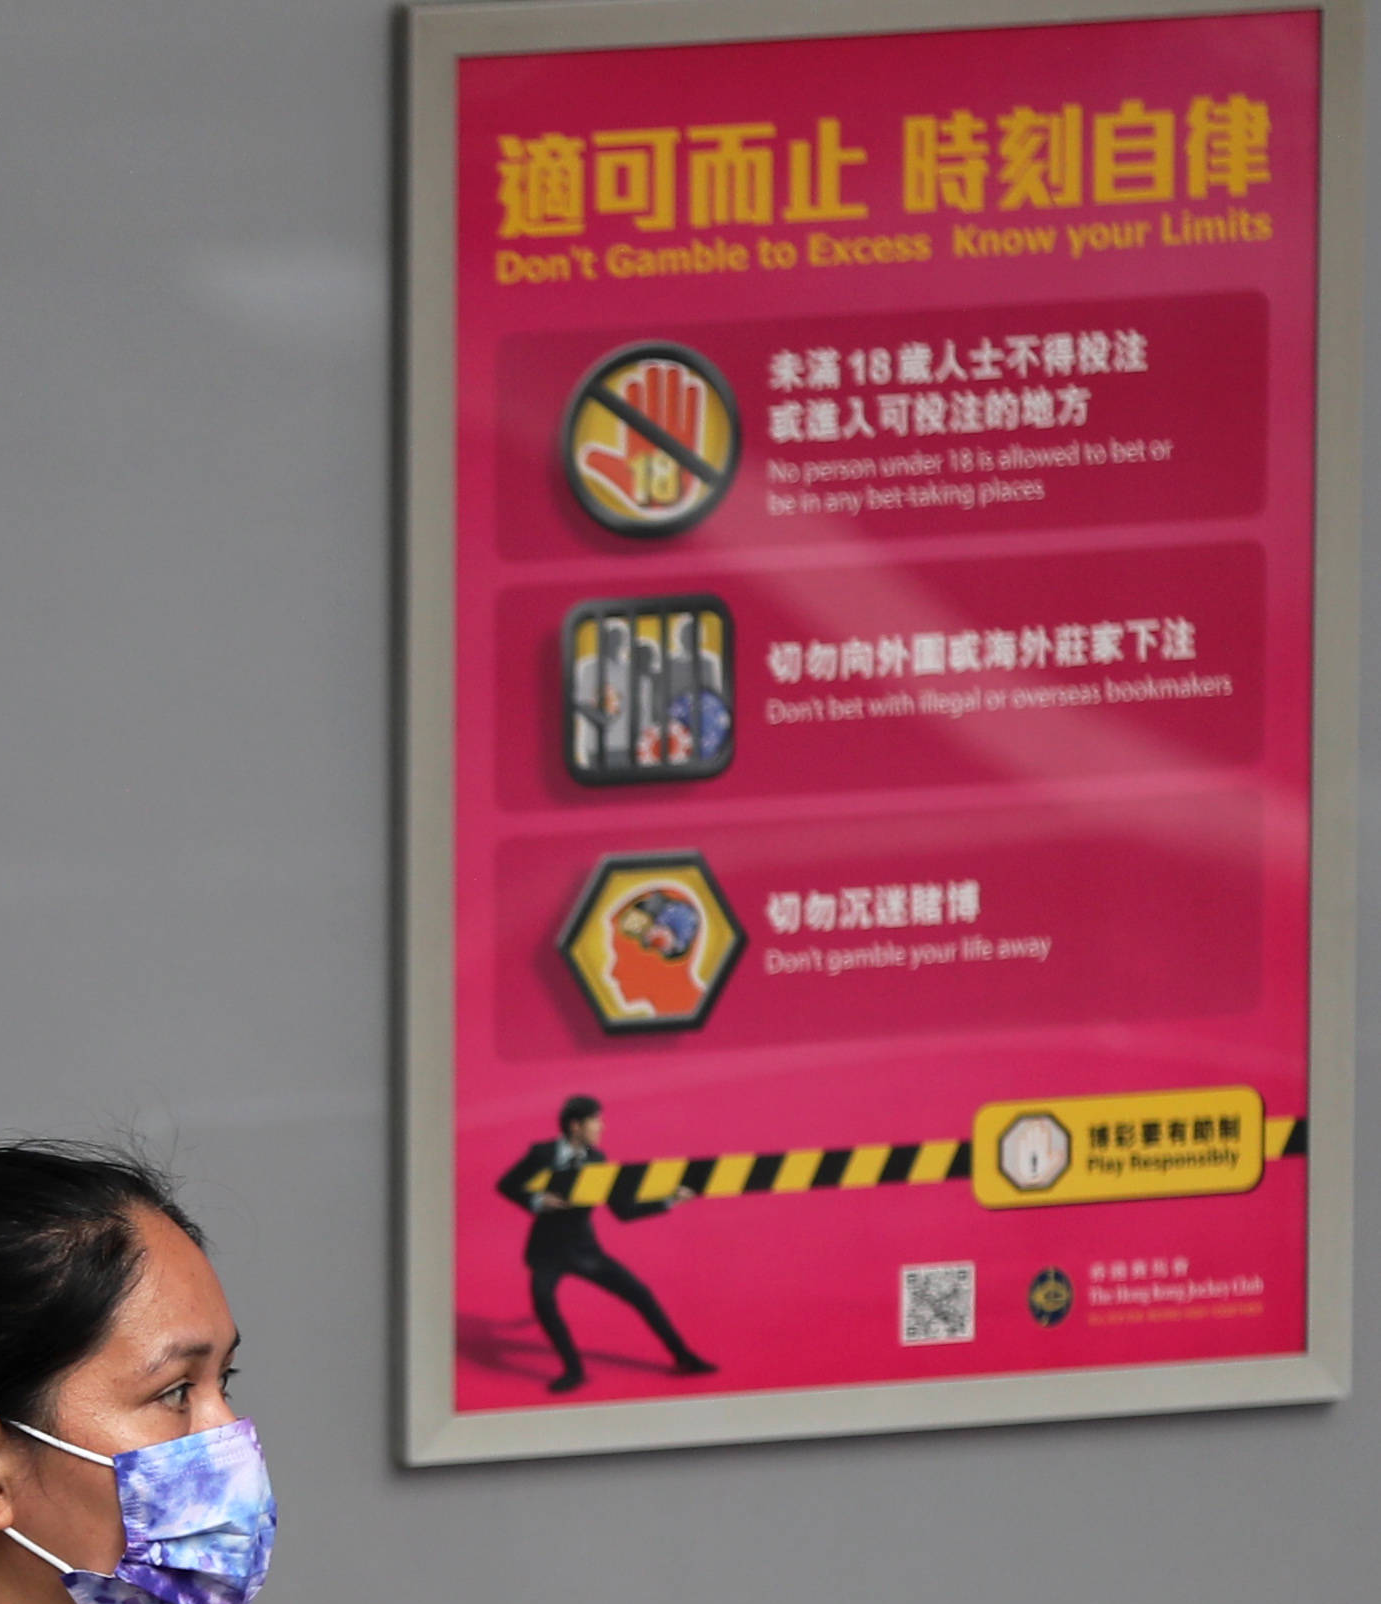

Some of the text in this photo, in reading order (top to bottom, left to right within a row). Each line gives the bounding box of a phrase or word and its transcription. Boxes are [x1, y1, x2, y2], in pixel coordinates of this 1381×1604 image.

[497, 93, 1271, 239] 適可而止 時刻自律
[496, 205, 1273, 284] Don't Gamble to Excess Know your Limits
[627, 449, 681, 505] 18
[768, 435, 1173, 488] No person under 18 is allowed to bet or
[768, 488, 796, 517] be
[799, 487, 821, 514] in
[823, 488, 863, 517] any
[976, 475, 1045, 508] places
[767, 672, 1233, 725] Don't bet with illegal or overseas bookmakers
[765, 934, 1051, 976] Don't gamble your life away
[1088, 1148, 1239, 1178] Play Responsibly
